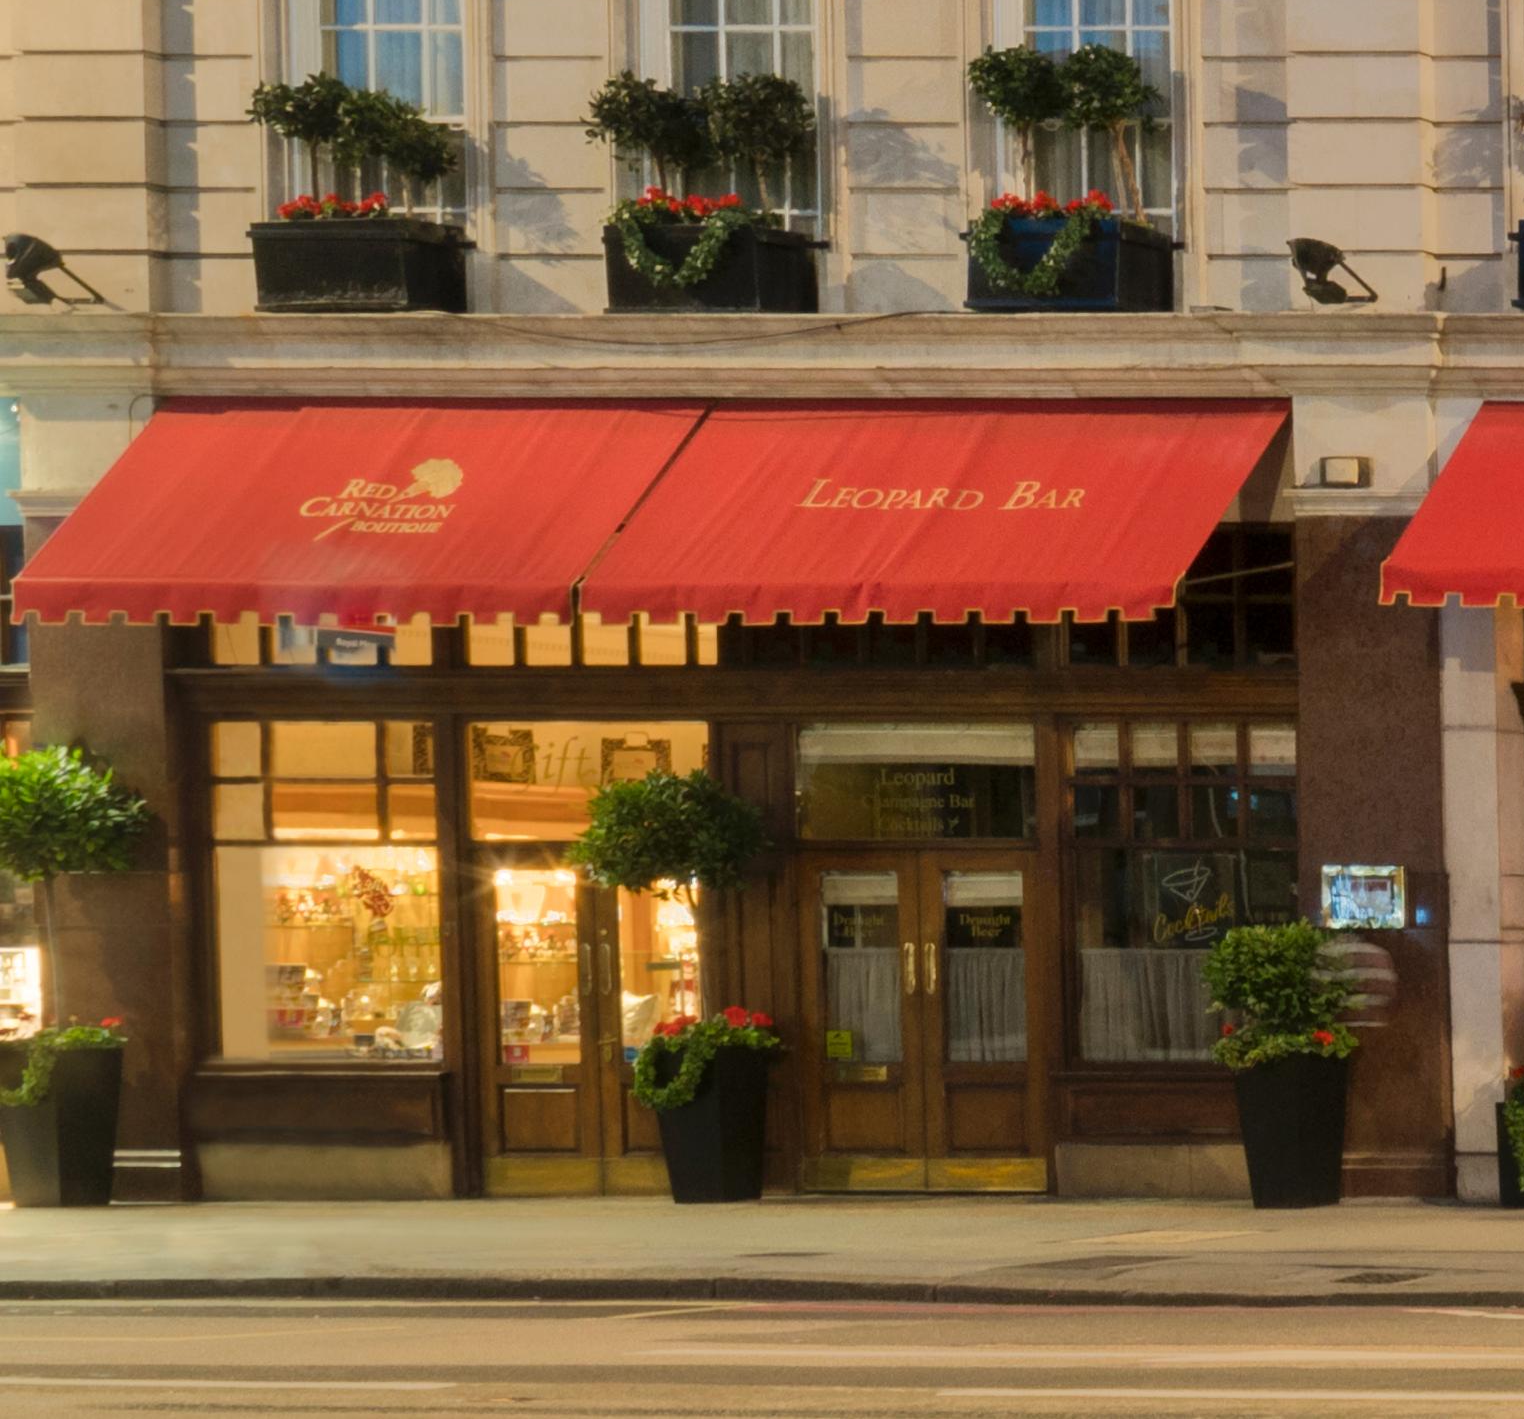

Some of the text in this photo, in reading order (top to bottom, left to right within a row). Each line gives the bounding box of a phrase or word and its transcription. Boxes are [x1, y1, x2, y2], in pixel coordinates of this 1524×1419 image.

[337, 478, 398, 499] RED
[795, 478, 1086, 510] LEOPARD BAR
[299, 496, 457, 519] CARNATION
[350, 521, 444, 534] BOUTIQUE
[880, 767, 956, 790] Leopard
